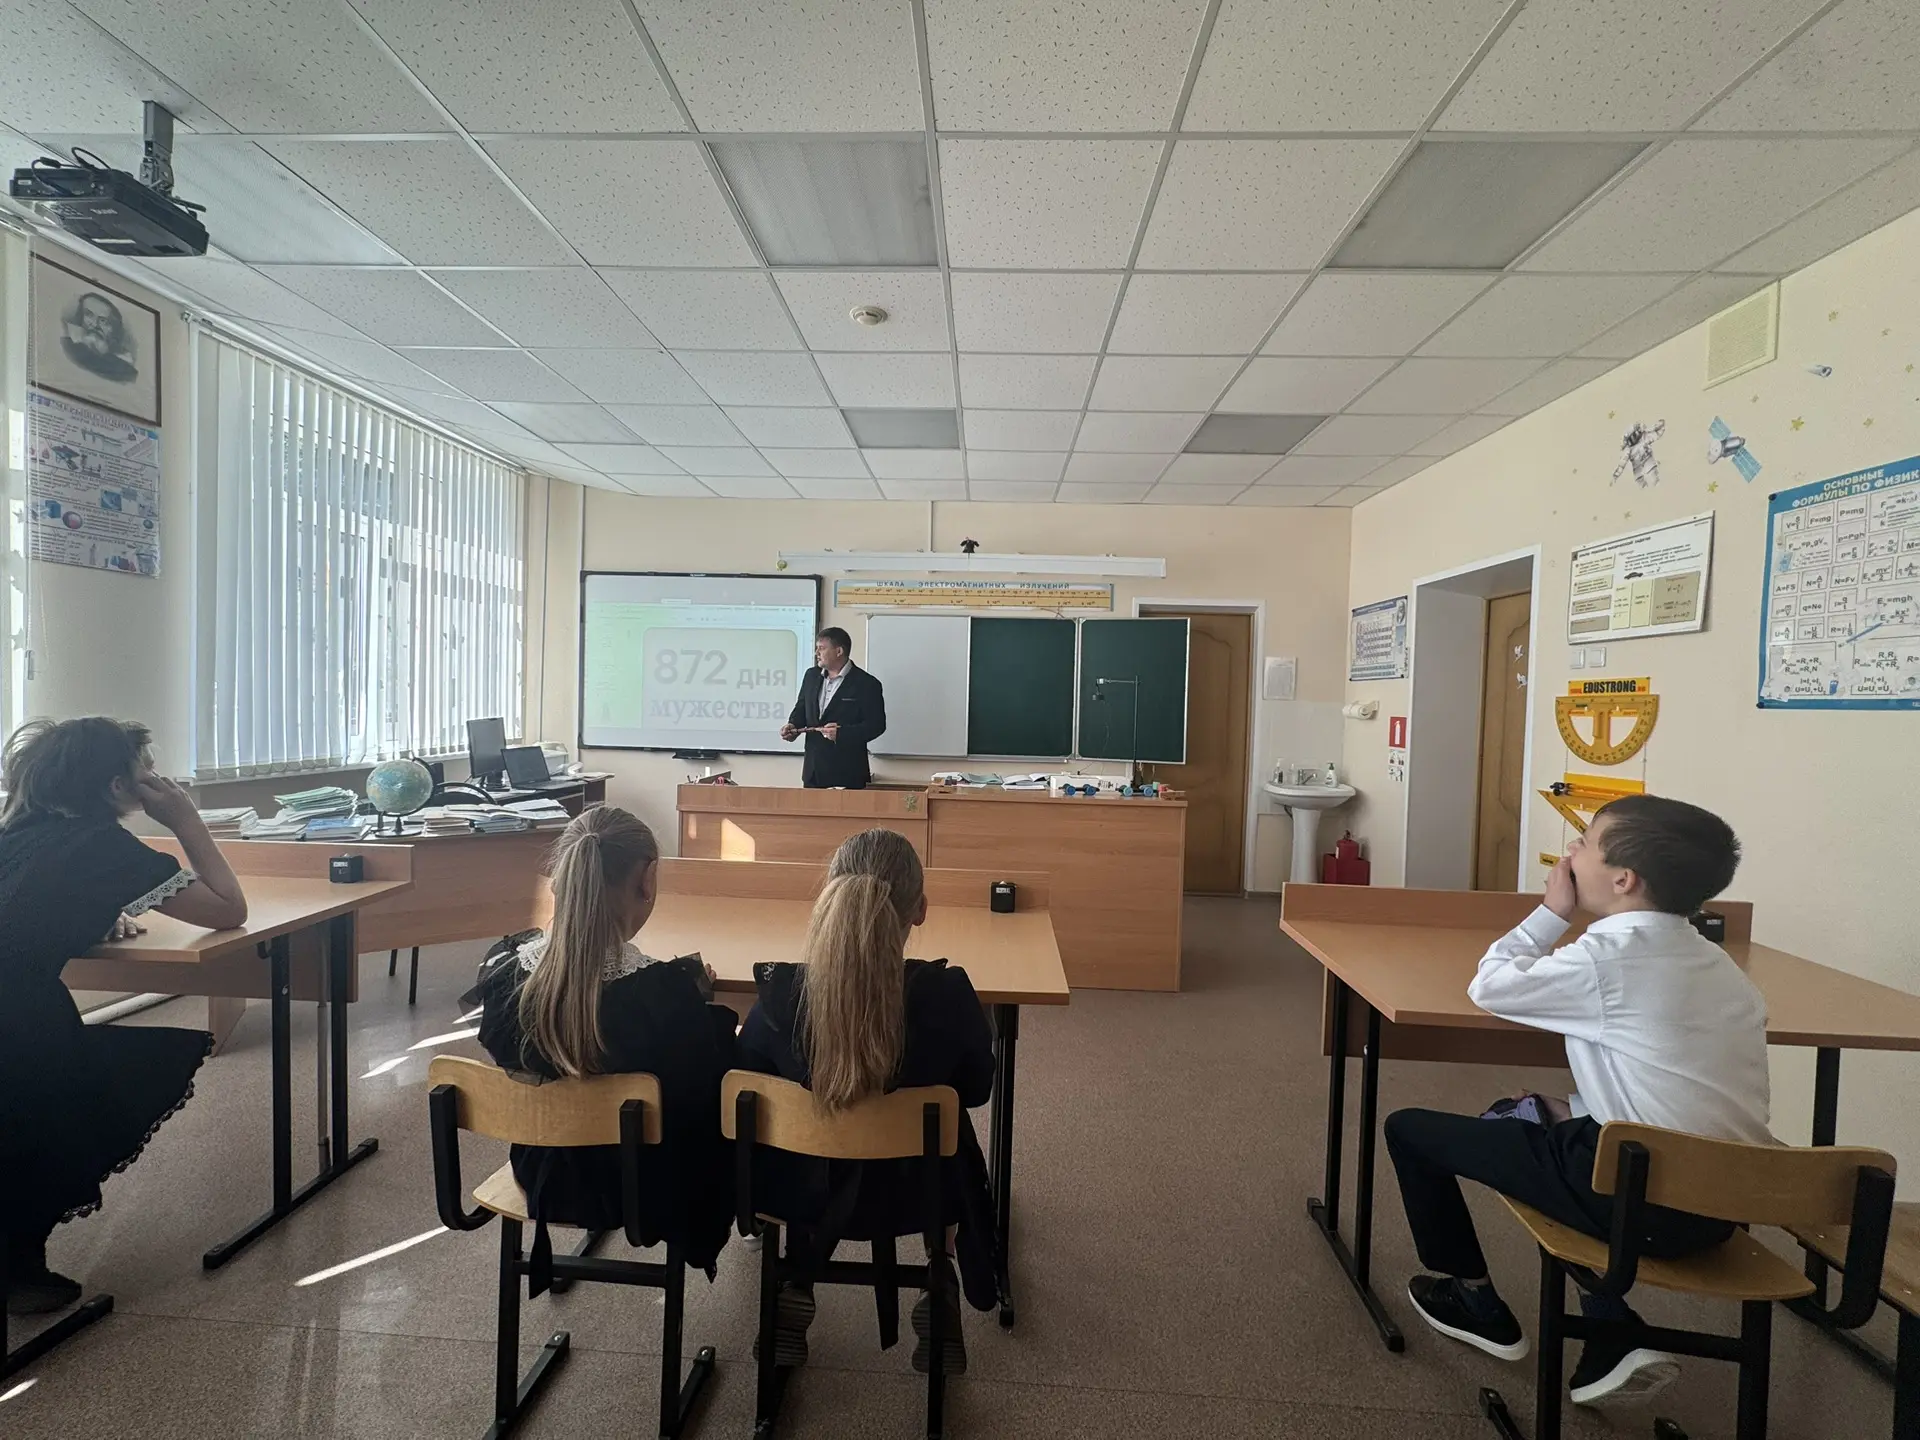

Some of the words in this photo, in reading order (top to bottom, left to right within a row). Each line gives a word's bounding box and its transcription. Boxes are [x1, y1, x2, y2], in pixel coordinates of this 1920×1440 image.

[1823, 469, 1884, 491] ОСНОВНЫЕ
[1792, 488, 1848, 508] ФОРМУЛЫ
[1851, 482, 1870, 494] ПО
[654, 648, 728, 685] 872
[736, 668, 787, 690] дня
[1583, 680, 1636, 693] EDUSTRONG
[650, 698, 786, 724] мужества
